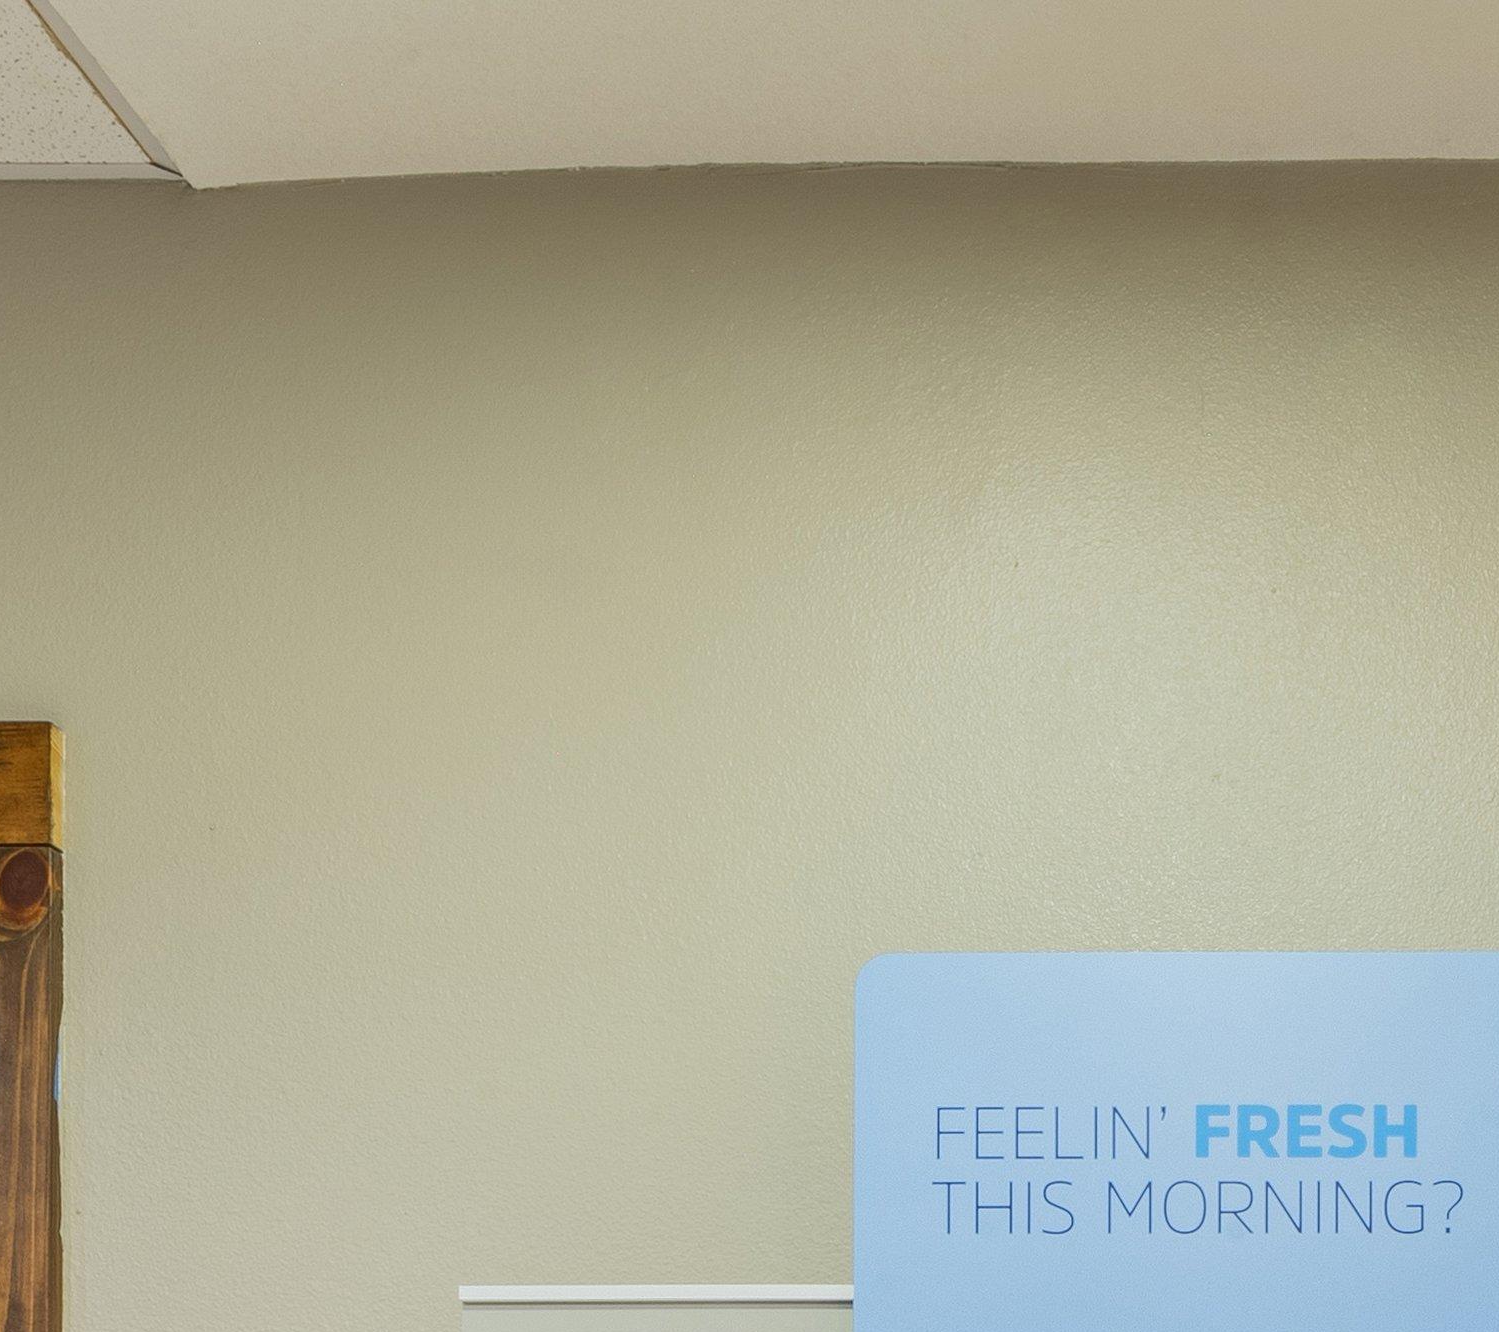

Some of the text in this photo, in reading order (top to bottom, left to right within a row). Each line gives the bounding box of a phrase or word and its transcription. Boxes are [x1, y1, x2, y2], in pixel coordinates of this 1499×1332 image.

[1195, 1103, 1418, 1159] FRESH
[931, 1179, 1465, 1236] THIS MORNING?
